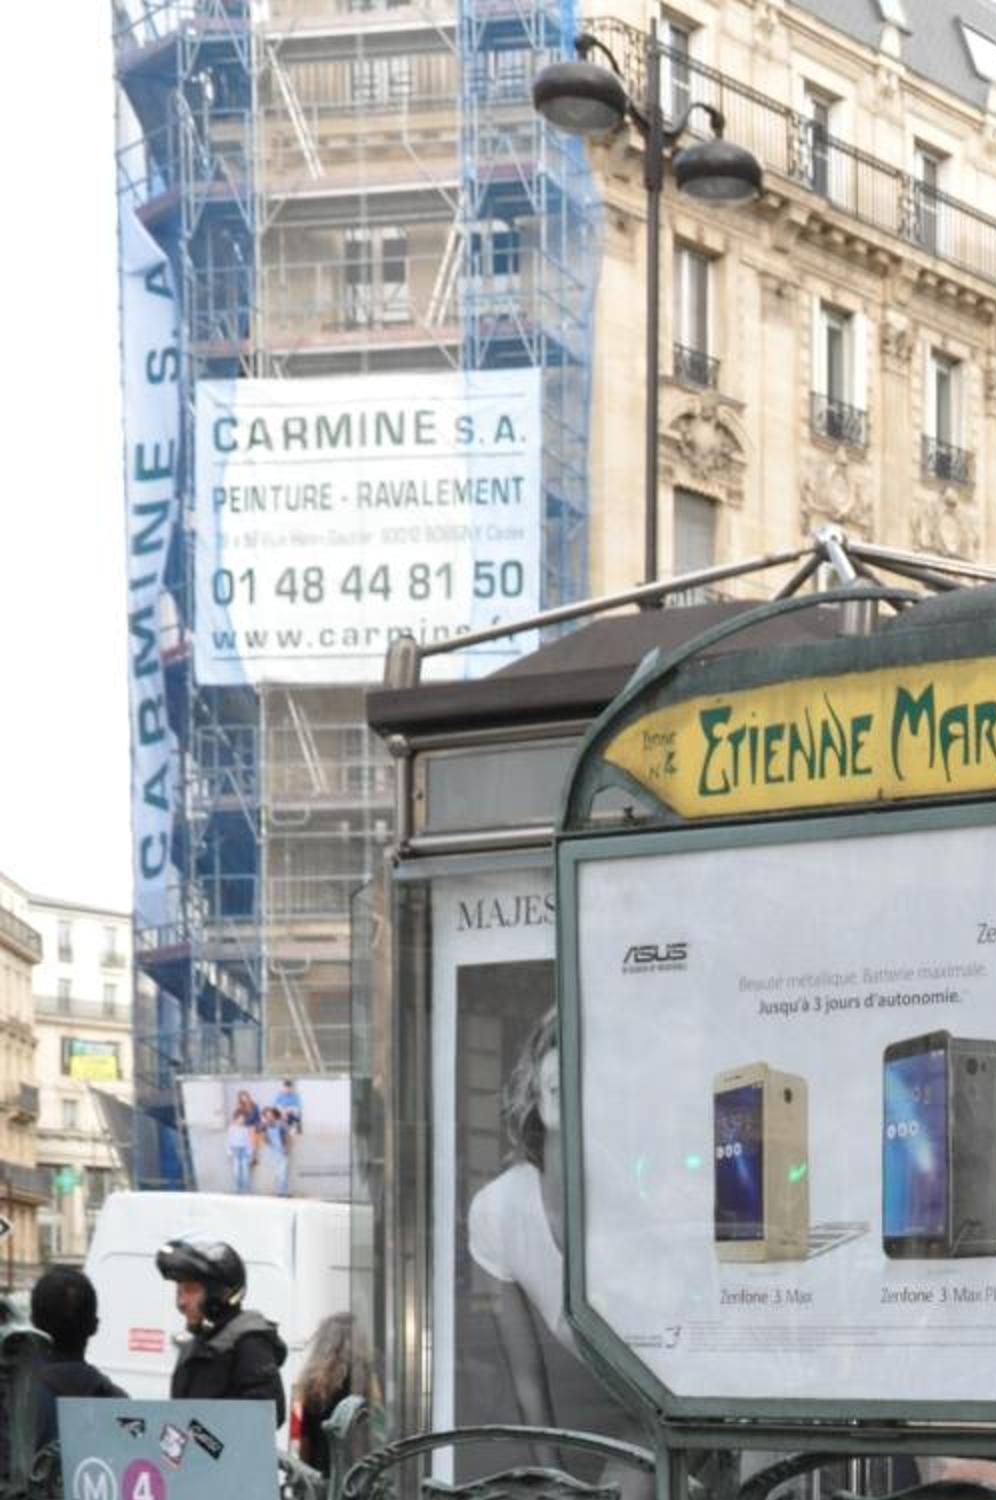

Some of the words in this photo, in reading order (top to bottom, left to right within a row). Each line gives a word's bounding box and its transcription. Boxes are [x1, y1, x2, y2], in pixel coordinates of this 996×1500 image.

[212, 409, 438, 451] CARMINE
[212, 482, 333, 514] PEINTURE
[356, 476, 525, 509] RAVALEMENT
[212, 567, 256, 607] 01
[275, 565, 325, 604] 48
[340, 563, 392, 602] 44
[408, 561, 454, 601] 81
[473, 559, 525, 599] 50
[127, 438, 176, 880] CARMINE
[622, 942, 688, 964] ASUS
[824, 995, 862, 1015] jours
